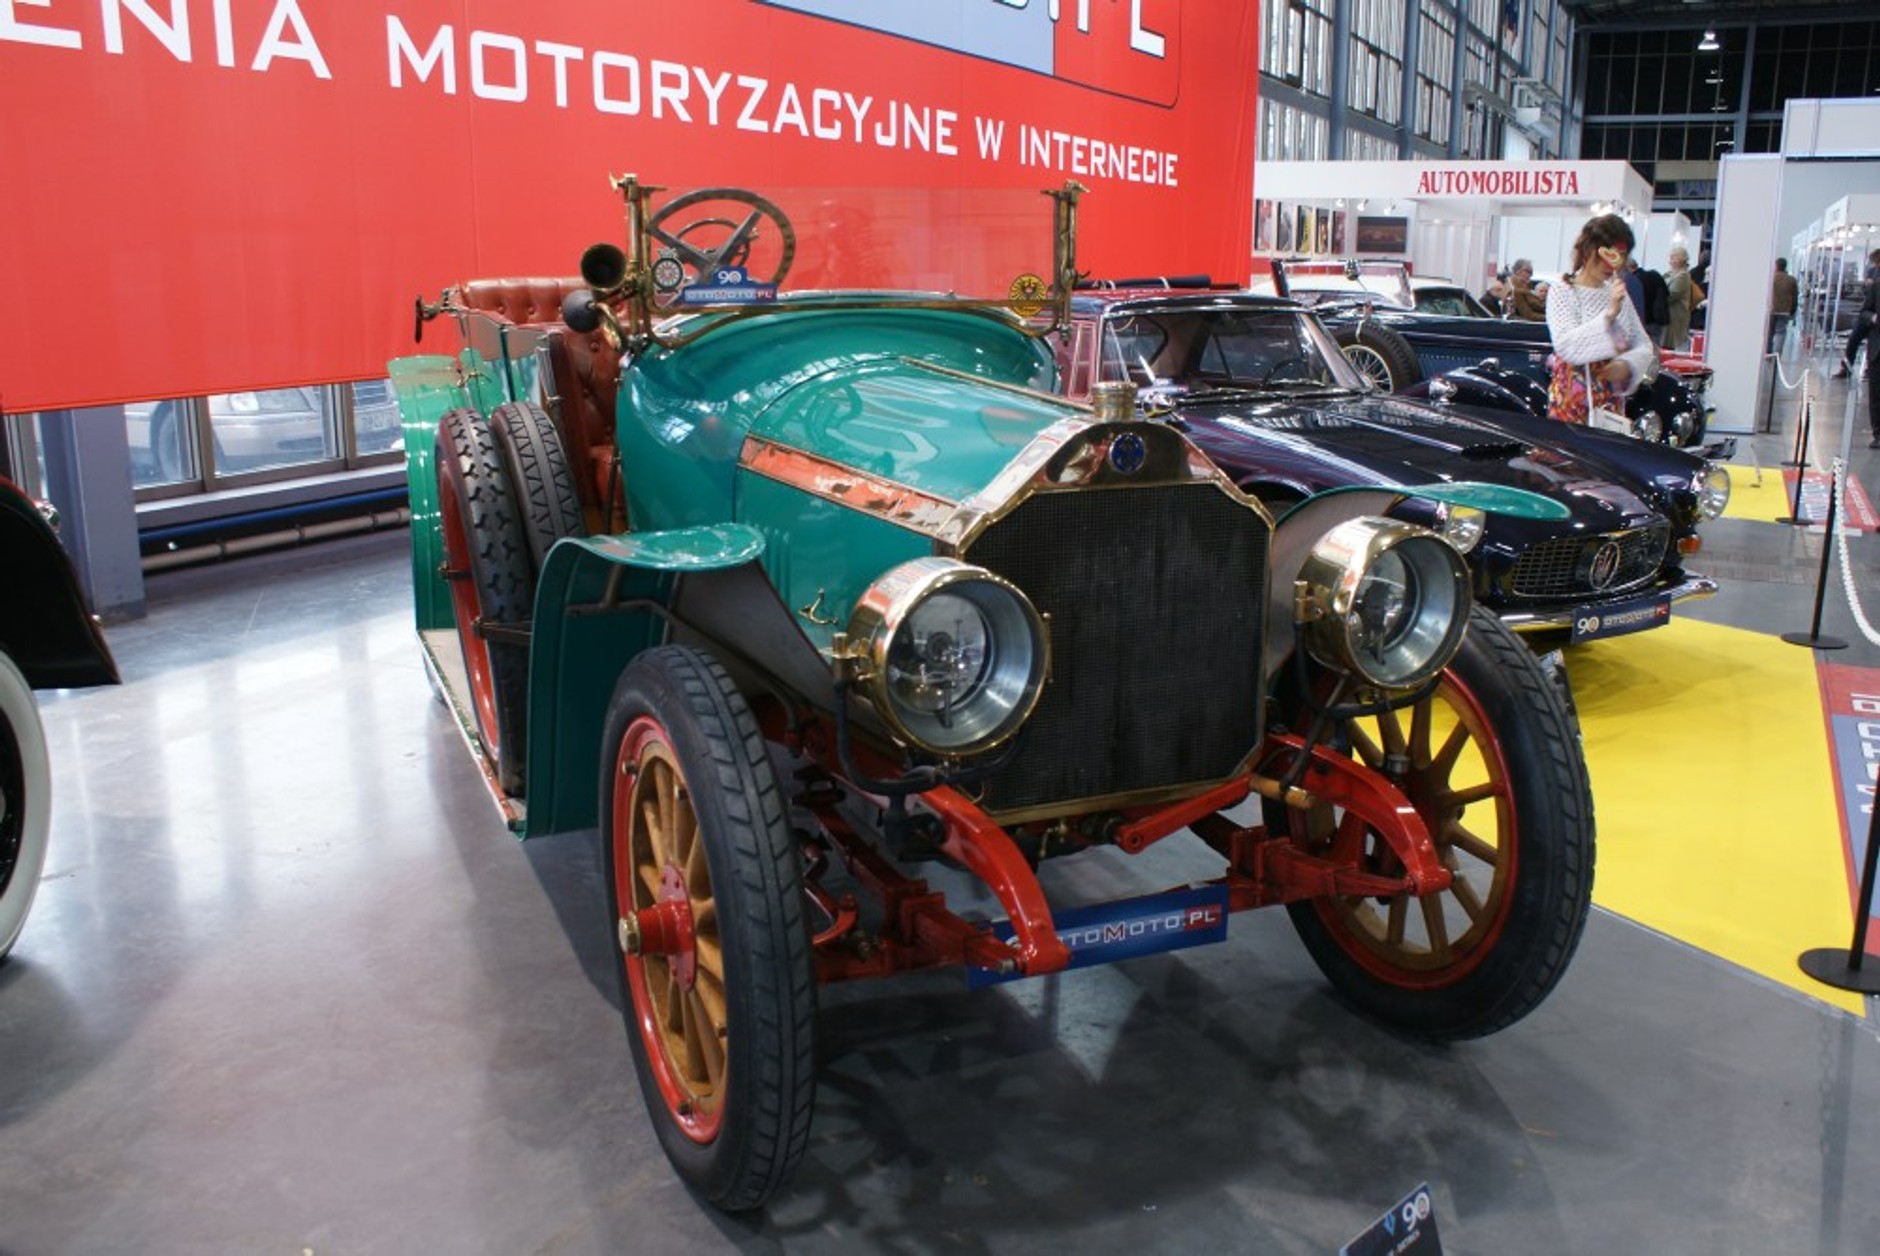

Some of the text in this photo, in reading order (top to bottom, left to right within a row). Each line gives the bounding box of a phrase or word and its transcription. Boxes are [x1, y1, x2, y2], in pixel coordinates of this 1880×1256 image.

[386, 14, 958, 156] MOTORYZACYJNE
[975, 116, 1004, 161] W
[1020, 125, 1178, 186] INTERNECIE
[1417, 170, 1579, 195] AUTOMOBILISTA
[717, 270, 742, 286] 90
[1577, 616, 1600, 635] 90
[1058, 910, 1217, 944] TOMOTO.PL
[1402, 1191, 1431, 1232] 90
